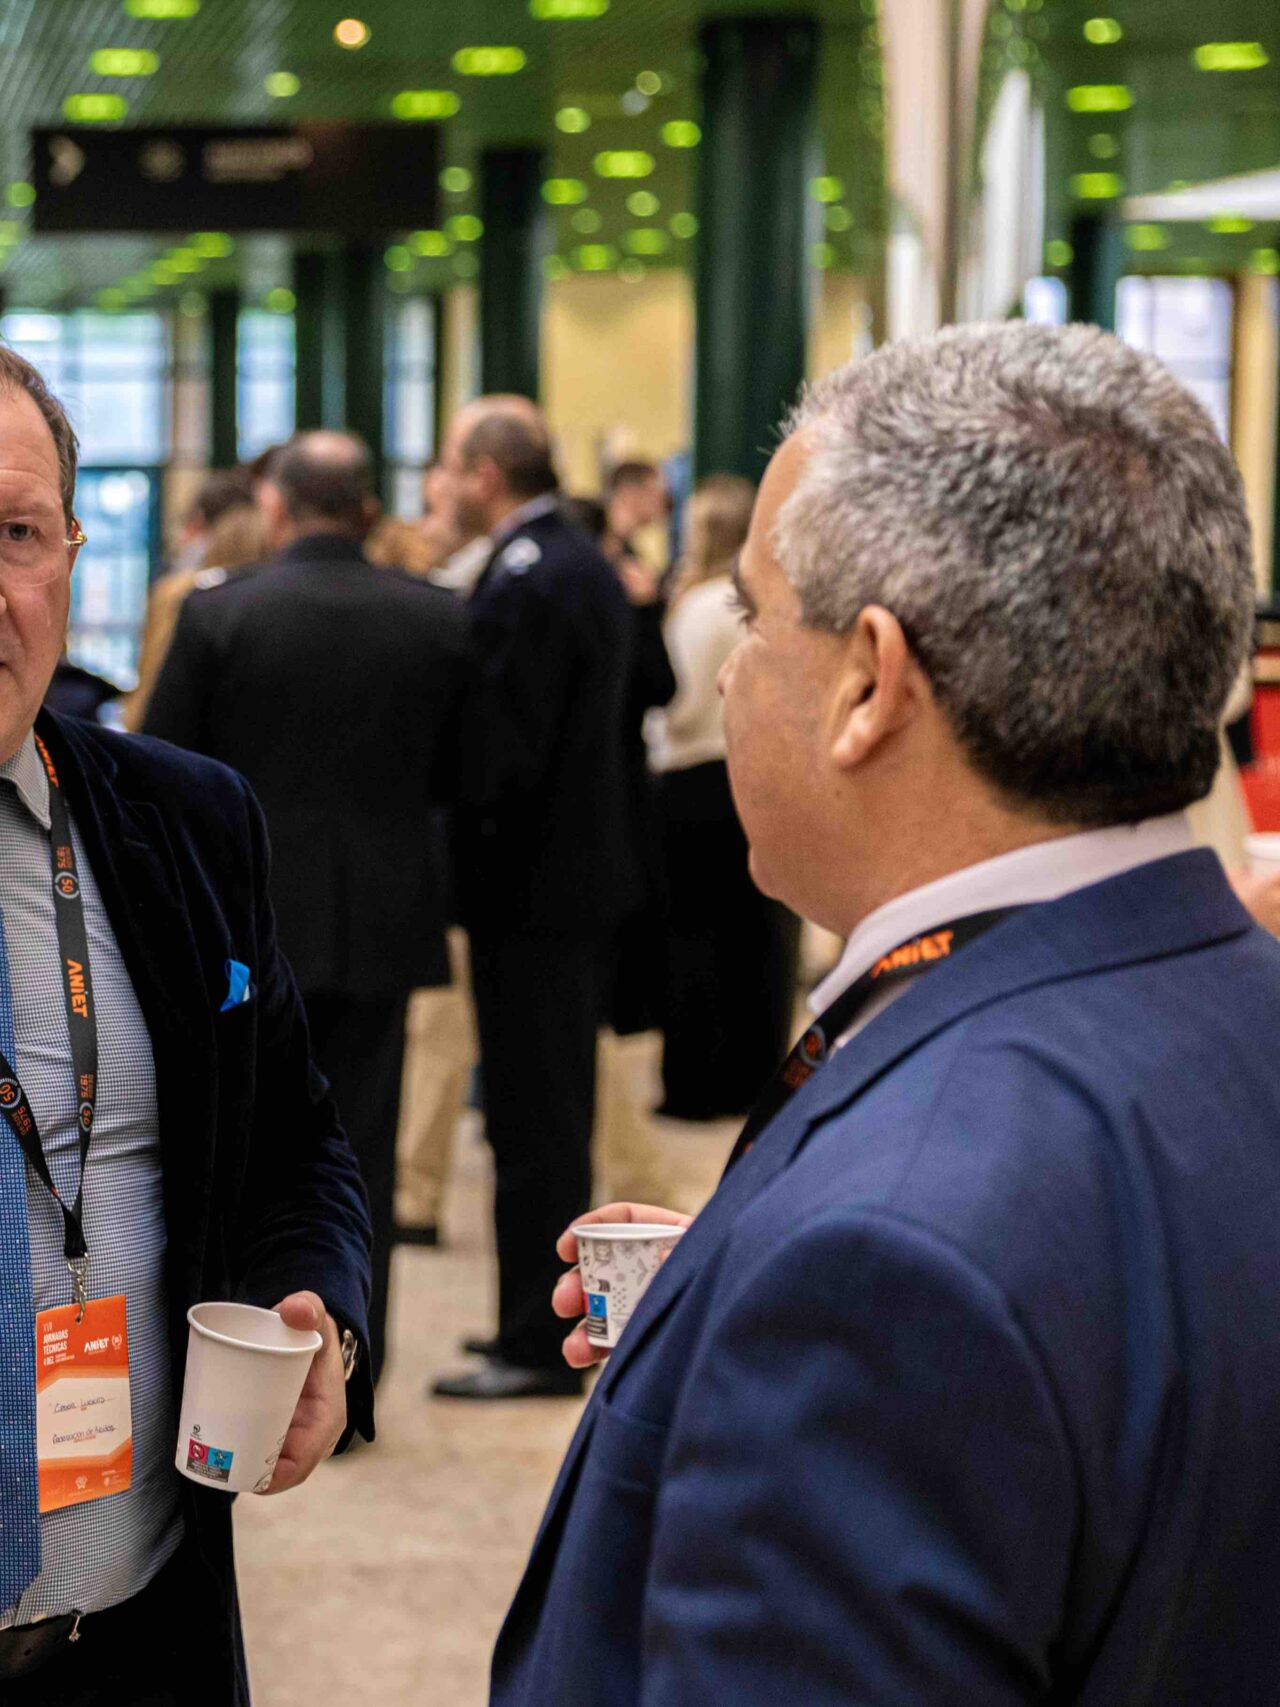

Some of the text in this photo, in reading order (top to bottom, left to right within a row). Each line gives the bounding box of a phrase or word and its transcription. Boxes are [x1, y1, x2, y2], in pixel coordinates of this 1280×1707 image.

[56, 847, 66, 868] 1975
[61, 878, 74, 893] 50
[0, 1083, 15, 1103] 50
[80, 1073, 88, 1098] 1975
[17, 1106, 33, 1131] 1975
[82, 1109, 91, 1125] 50
